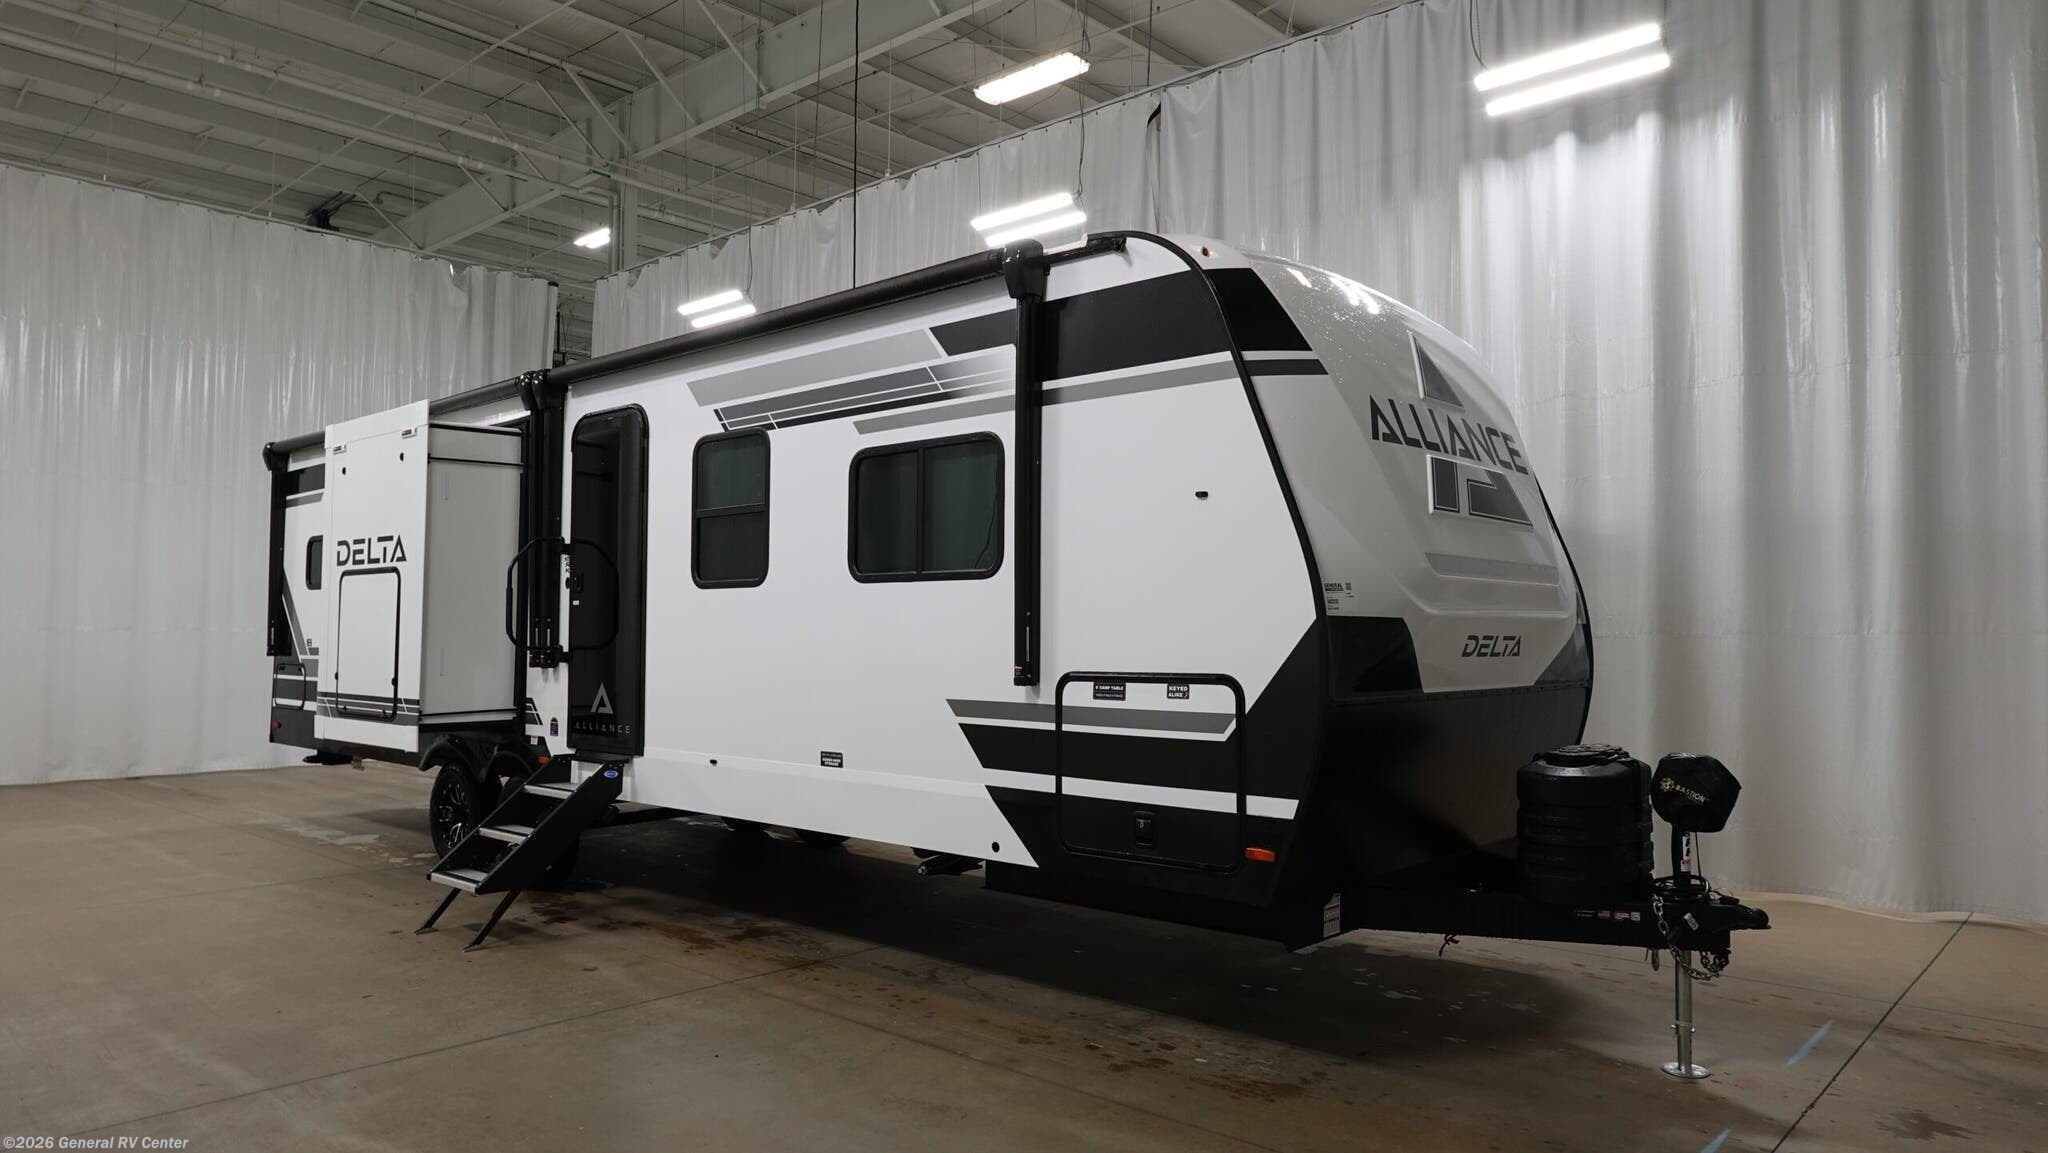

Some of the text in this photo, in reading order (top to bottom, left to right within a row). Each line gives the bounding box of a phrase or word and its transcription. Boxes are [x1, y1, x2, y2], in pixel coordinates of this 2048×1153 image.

[1369, 394, 1529, 476] ALLIANCE
[336, 534, 407, 566] DELTA
[1461, 634, 1521, 658] DELTA
[575, 720, 632, 735] ALLIANCE
[1675, 784, 1706, 803] BASTION
